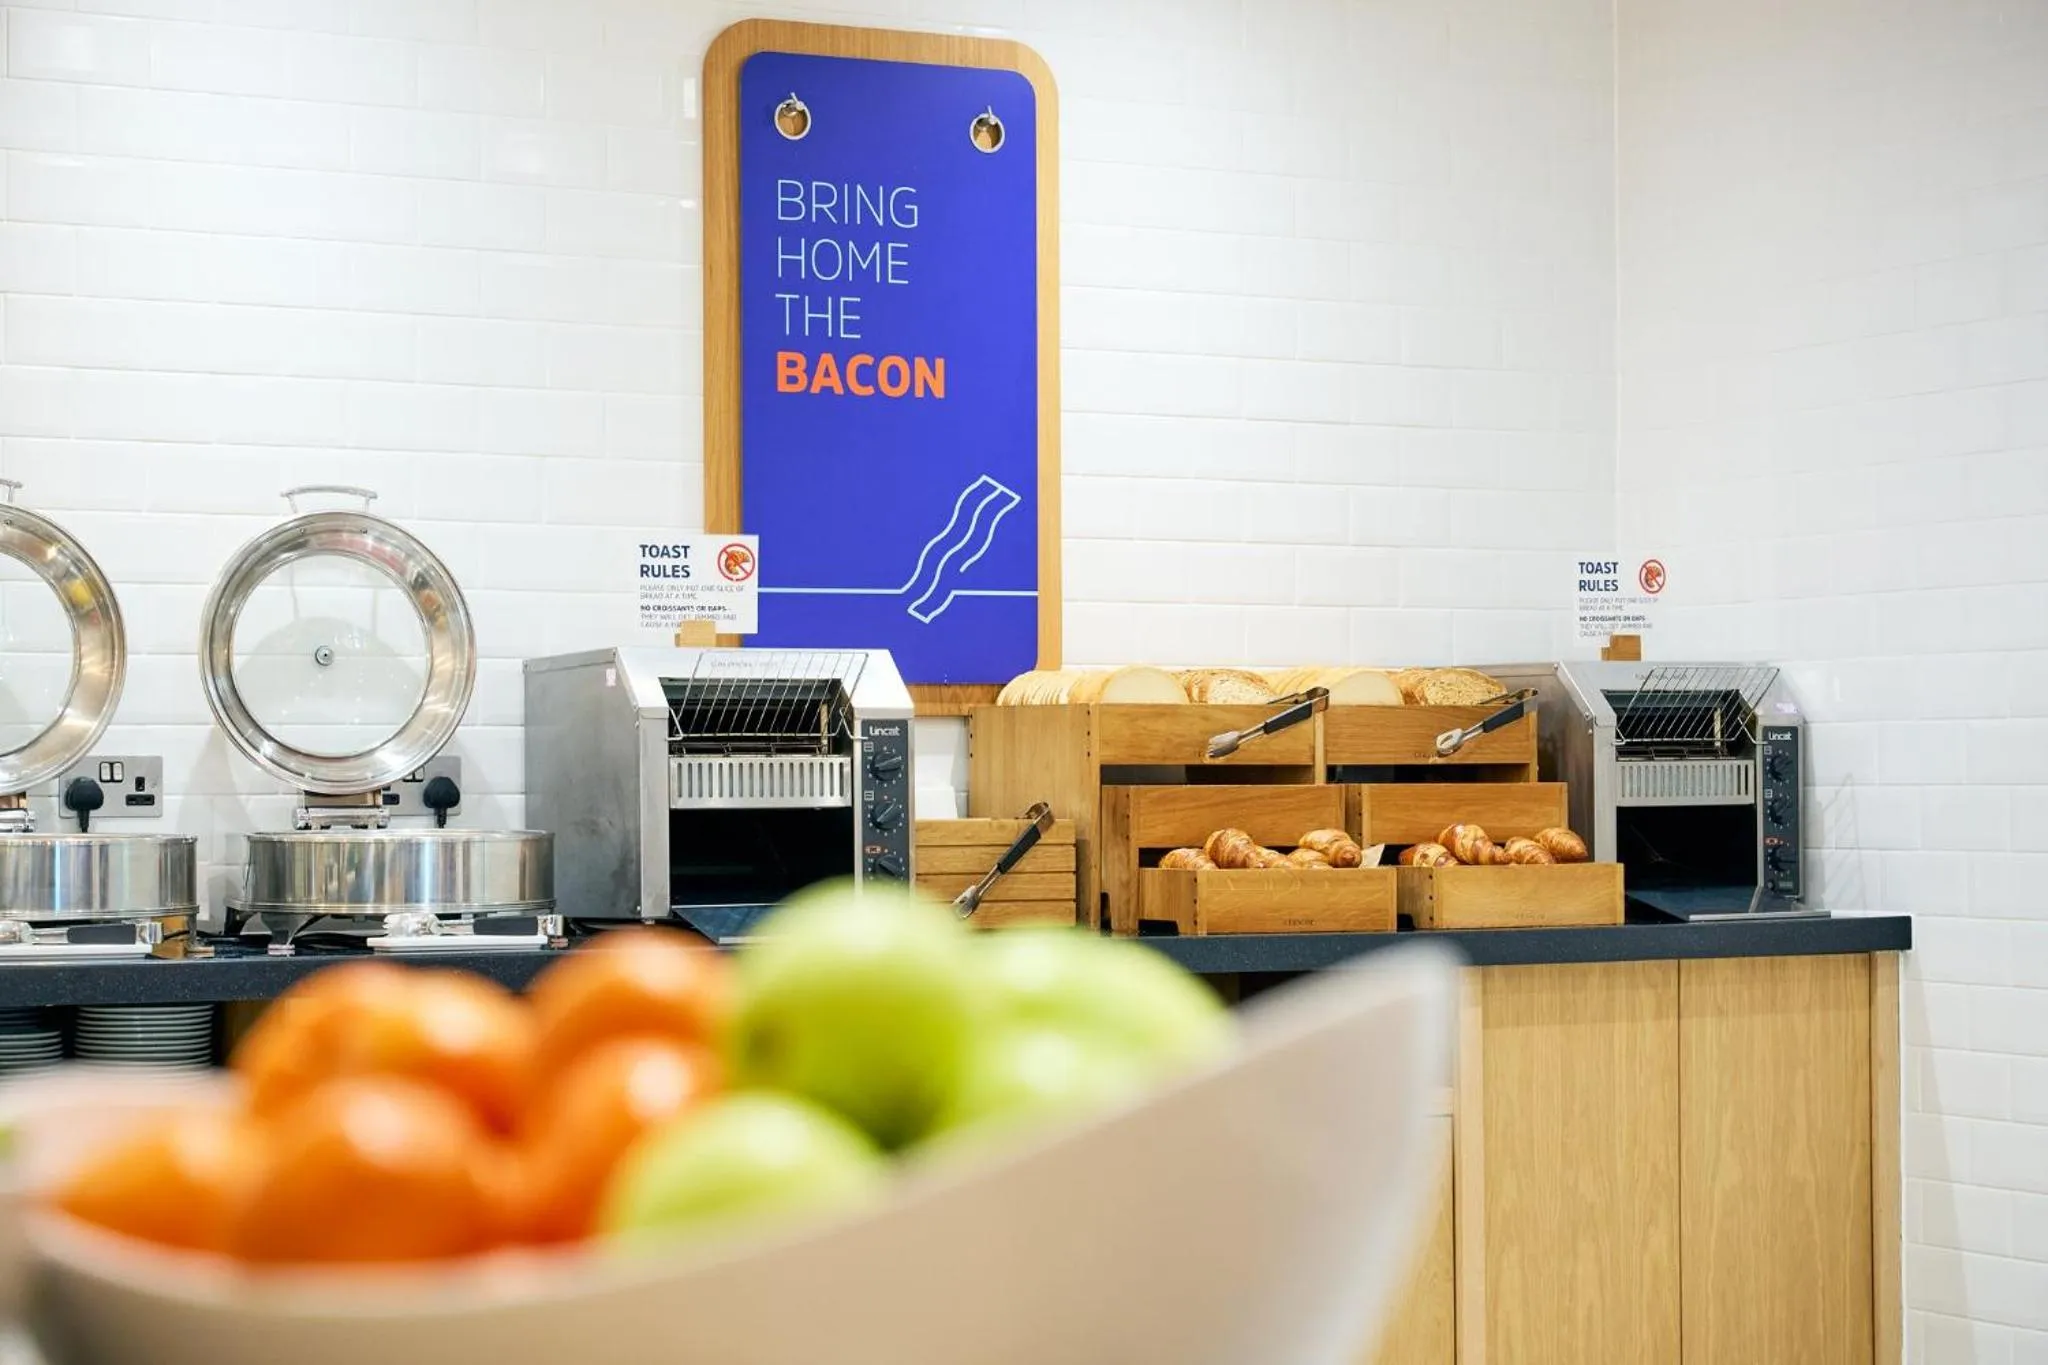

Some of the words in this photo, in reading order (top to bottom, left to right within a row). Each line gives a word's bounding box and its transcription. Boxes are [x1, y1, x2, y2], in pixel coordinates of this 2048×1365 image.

[777, 179, 918, 229] BRING
[777, 236, 909, 285] HOME
[775, 293, 861, 339] THE
[776, 350, 946, 399] BACON
[639, 543, 691, 559] TOAST
[639, 563, 691, 579] RULES
[1578, 561, 1619, 575] TOAST
[1578, 579, 1619, 592] RULES
[869, 726, 901, 736] Lincat
